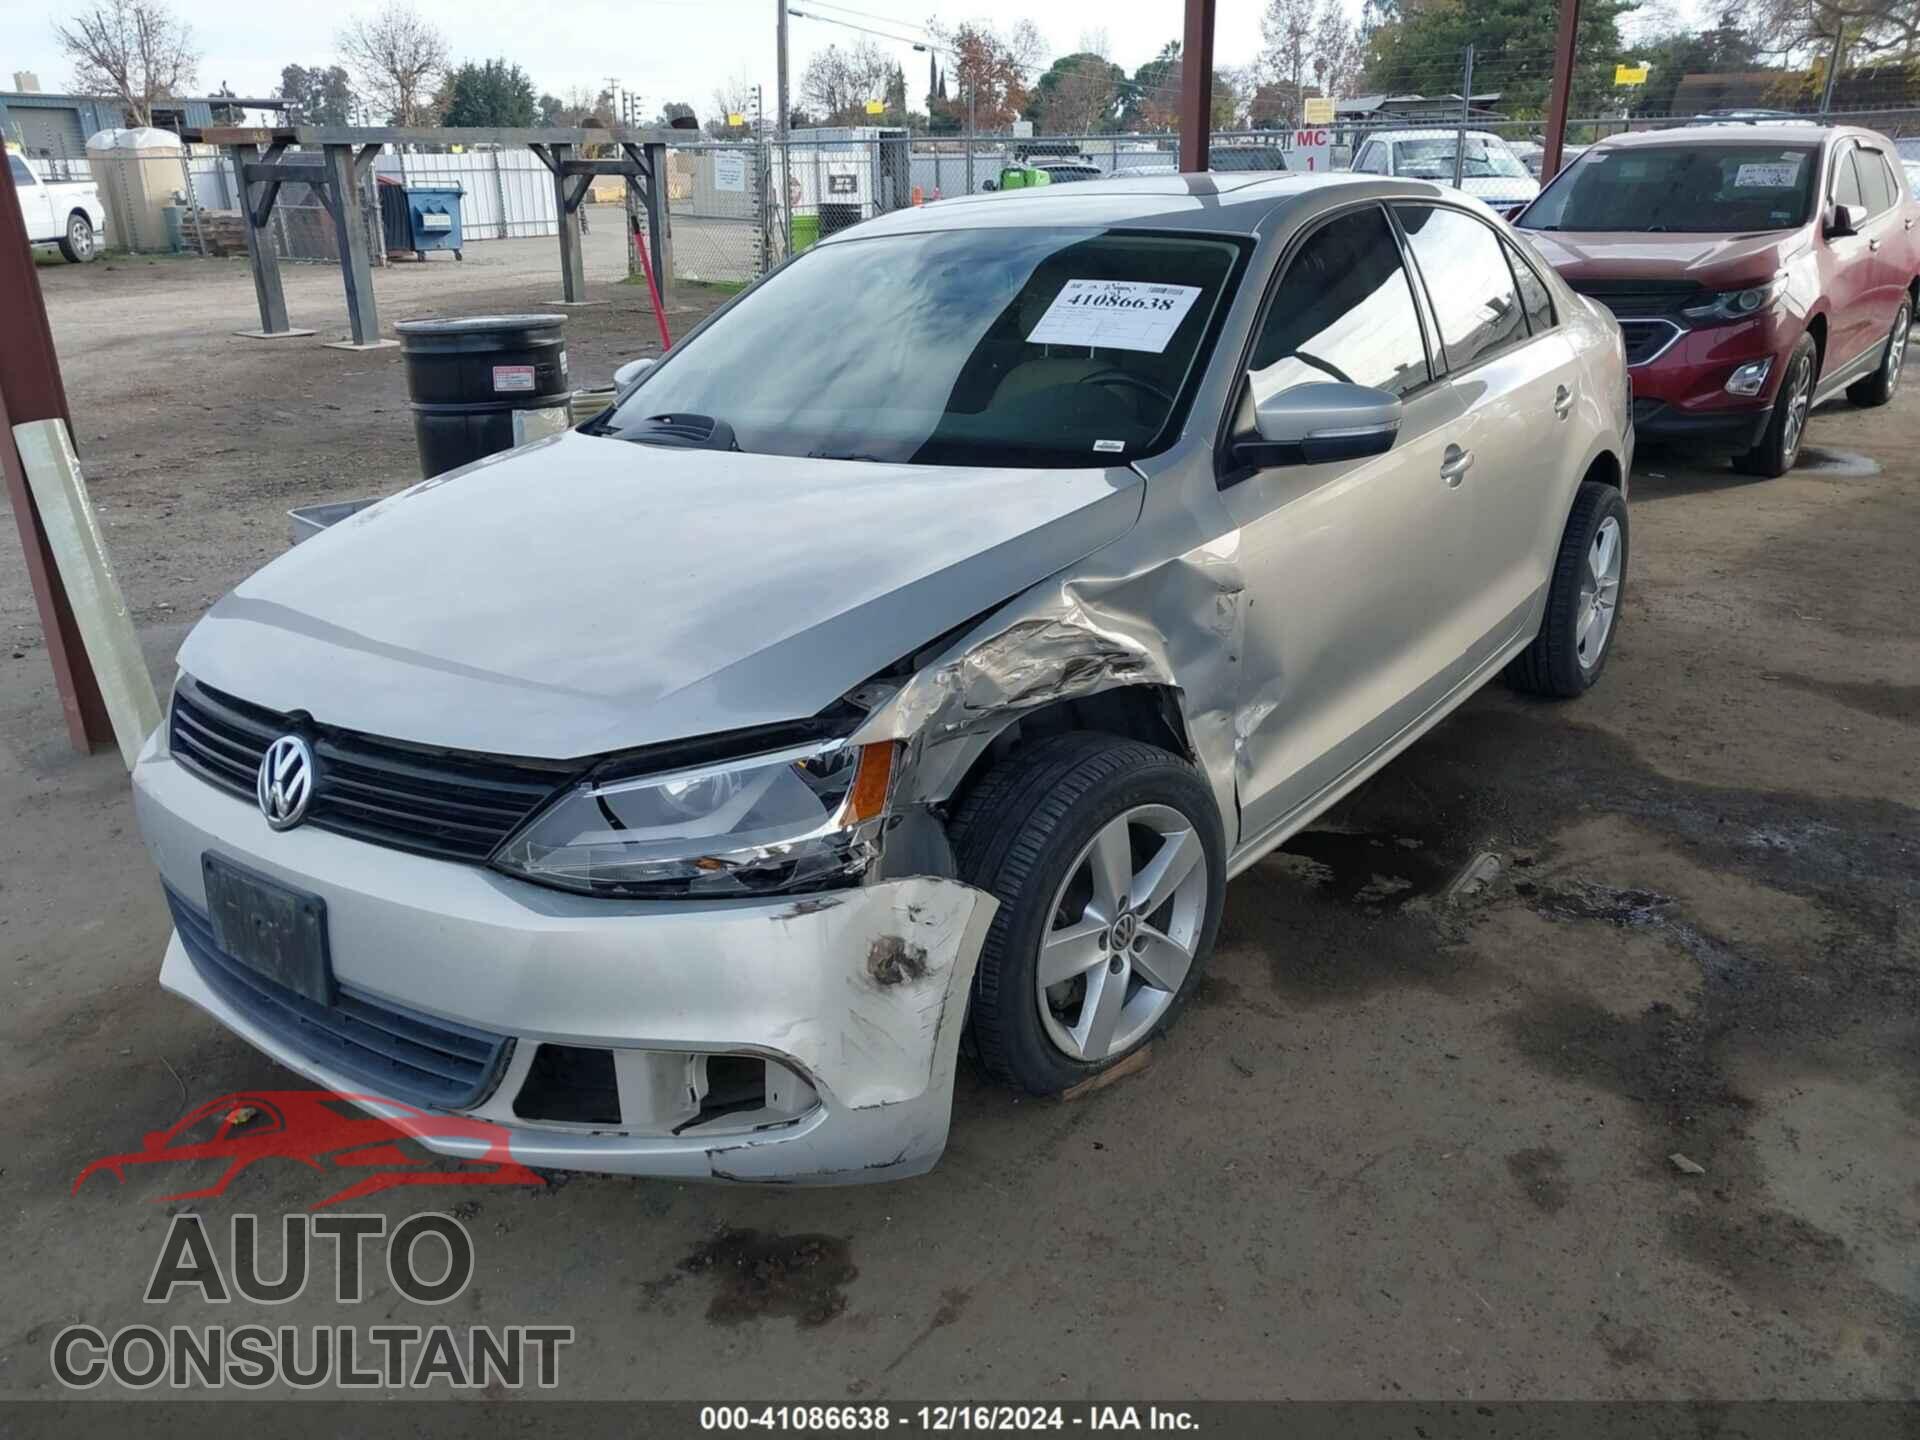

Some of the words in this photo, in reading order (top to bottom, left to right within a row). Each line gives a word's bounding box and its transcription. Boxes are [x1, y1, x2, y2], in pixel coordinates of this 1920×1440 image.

[1297, 130, 1327, 147] MC
[1307, 156, 1314, 171] 1
[1067, 294, 1175, 311] 41086638
